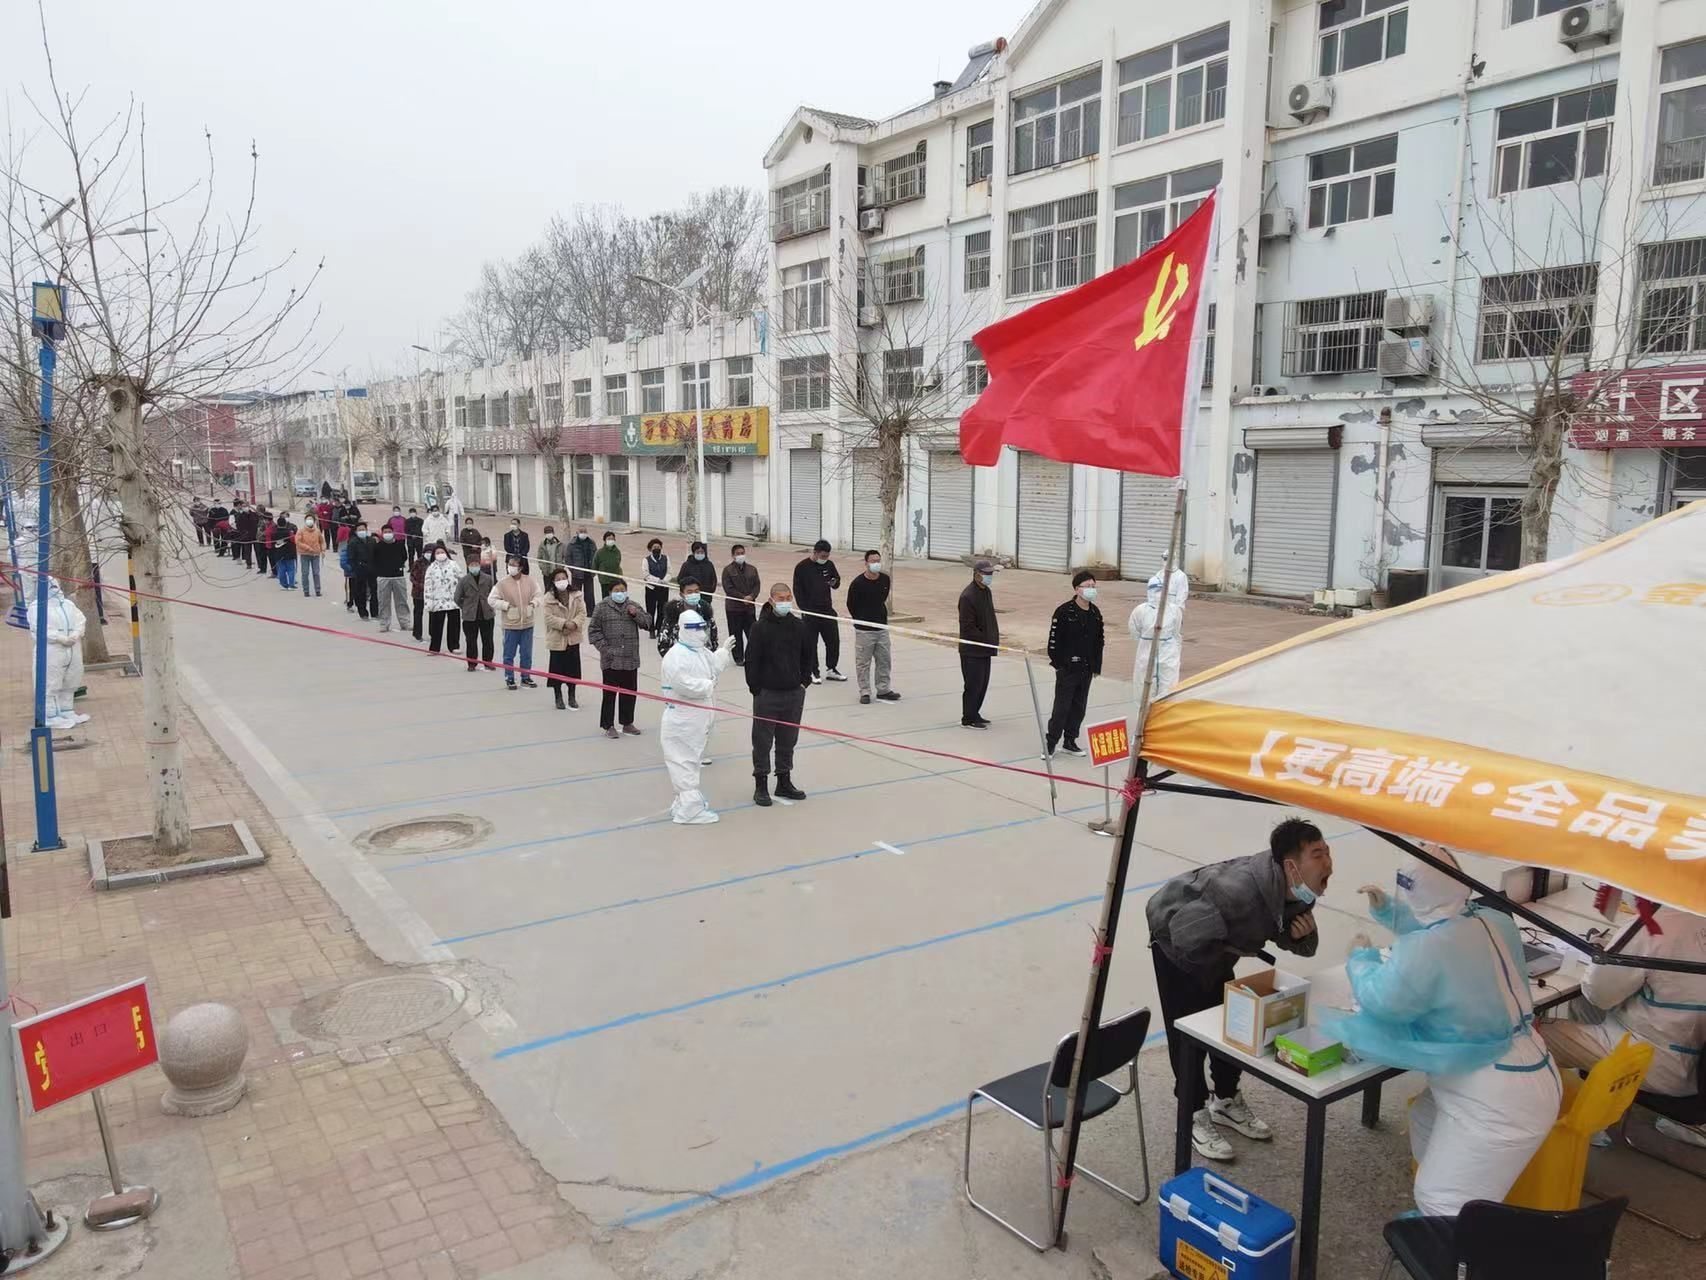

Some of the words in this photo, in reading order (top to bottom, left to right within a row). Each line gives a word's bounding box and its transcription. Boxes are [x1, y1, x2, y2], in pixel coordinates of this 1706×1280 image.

[1091, 727, 1128, 759] 体温测量处
[68, 1023, 108, 1047] 出口
